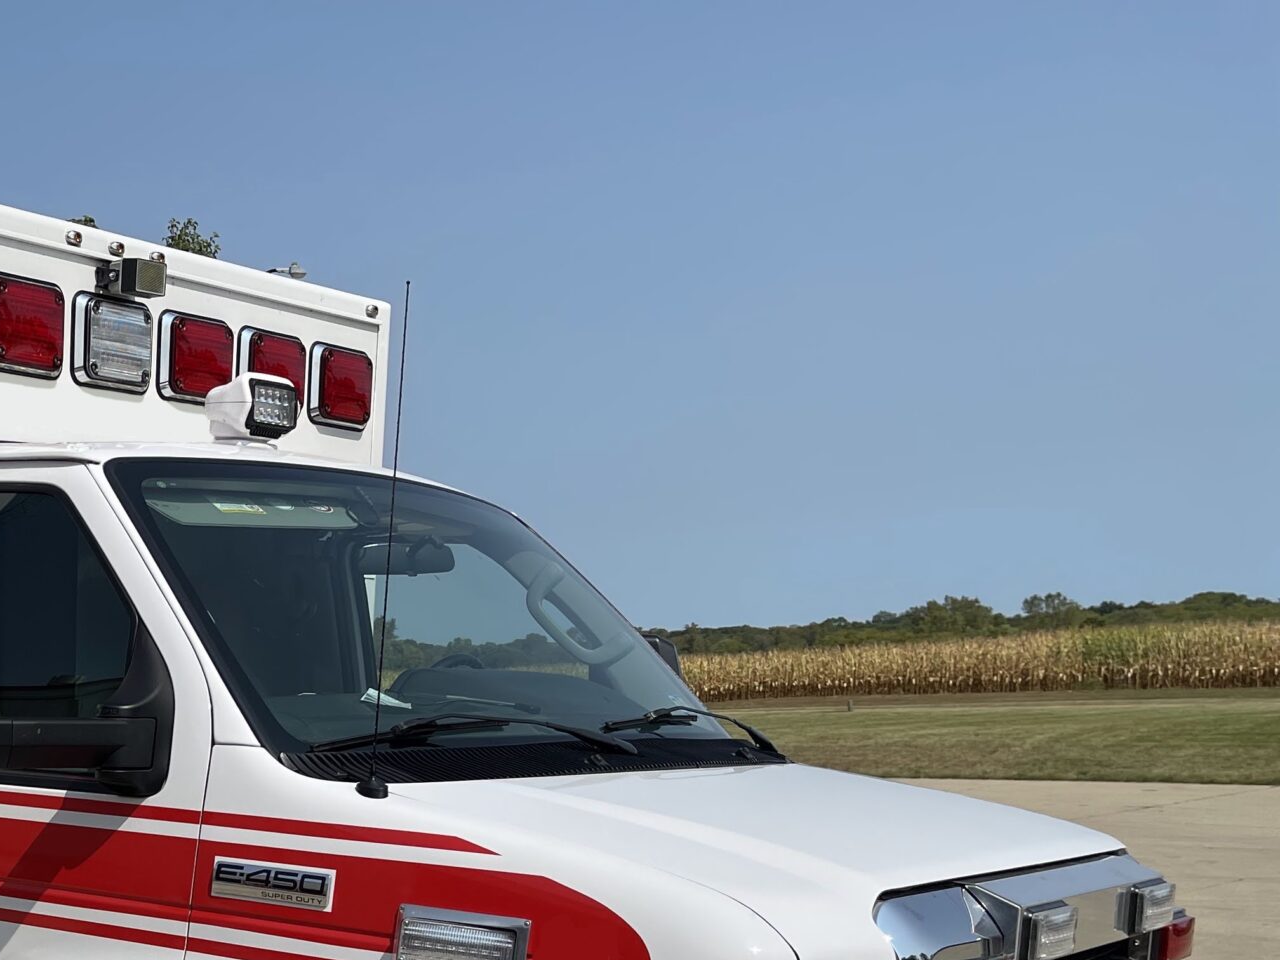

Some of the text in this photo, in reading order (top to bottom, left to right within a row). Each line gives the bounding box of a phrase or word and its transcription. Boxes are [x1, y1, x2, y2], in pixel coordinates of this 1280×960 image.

[215, 863, 326, 895] E-450
[261, 891, 323, 905] SUPER DUTY
